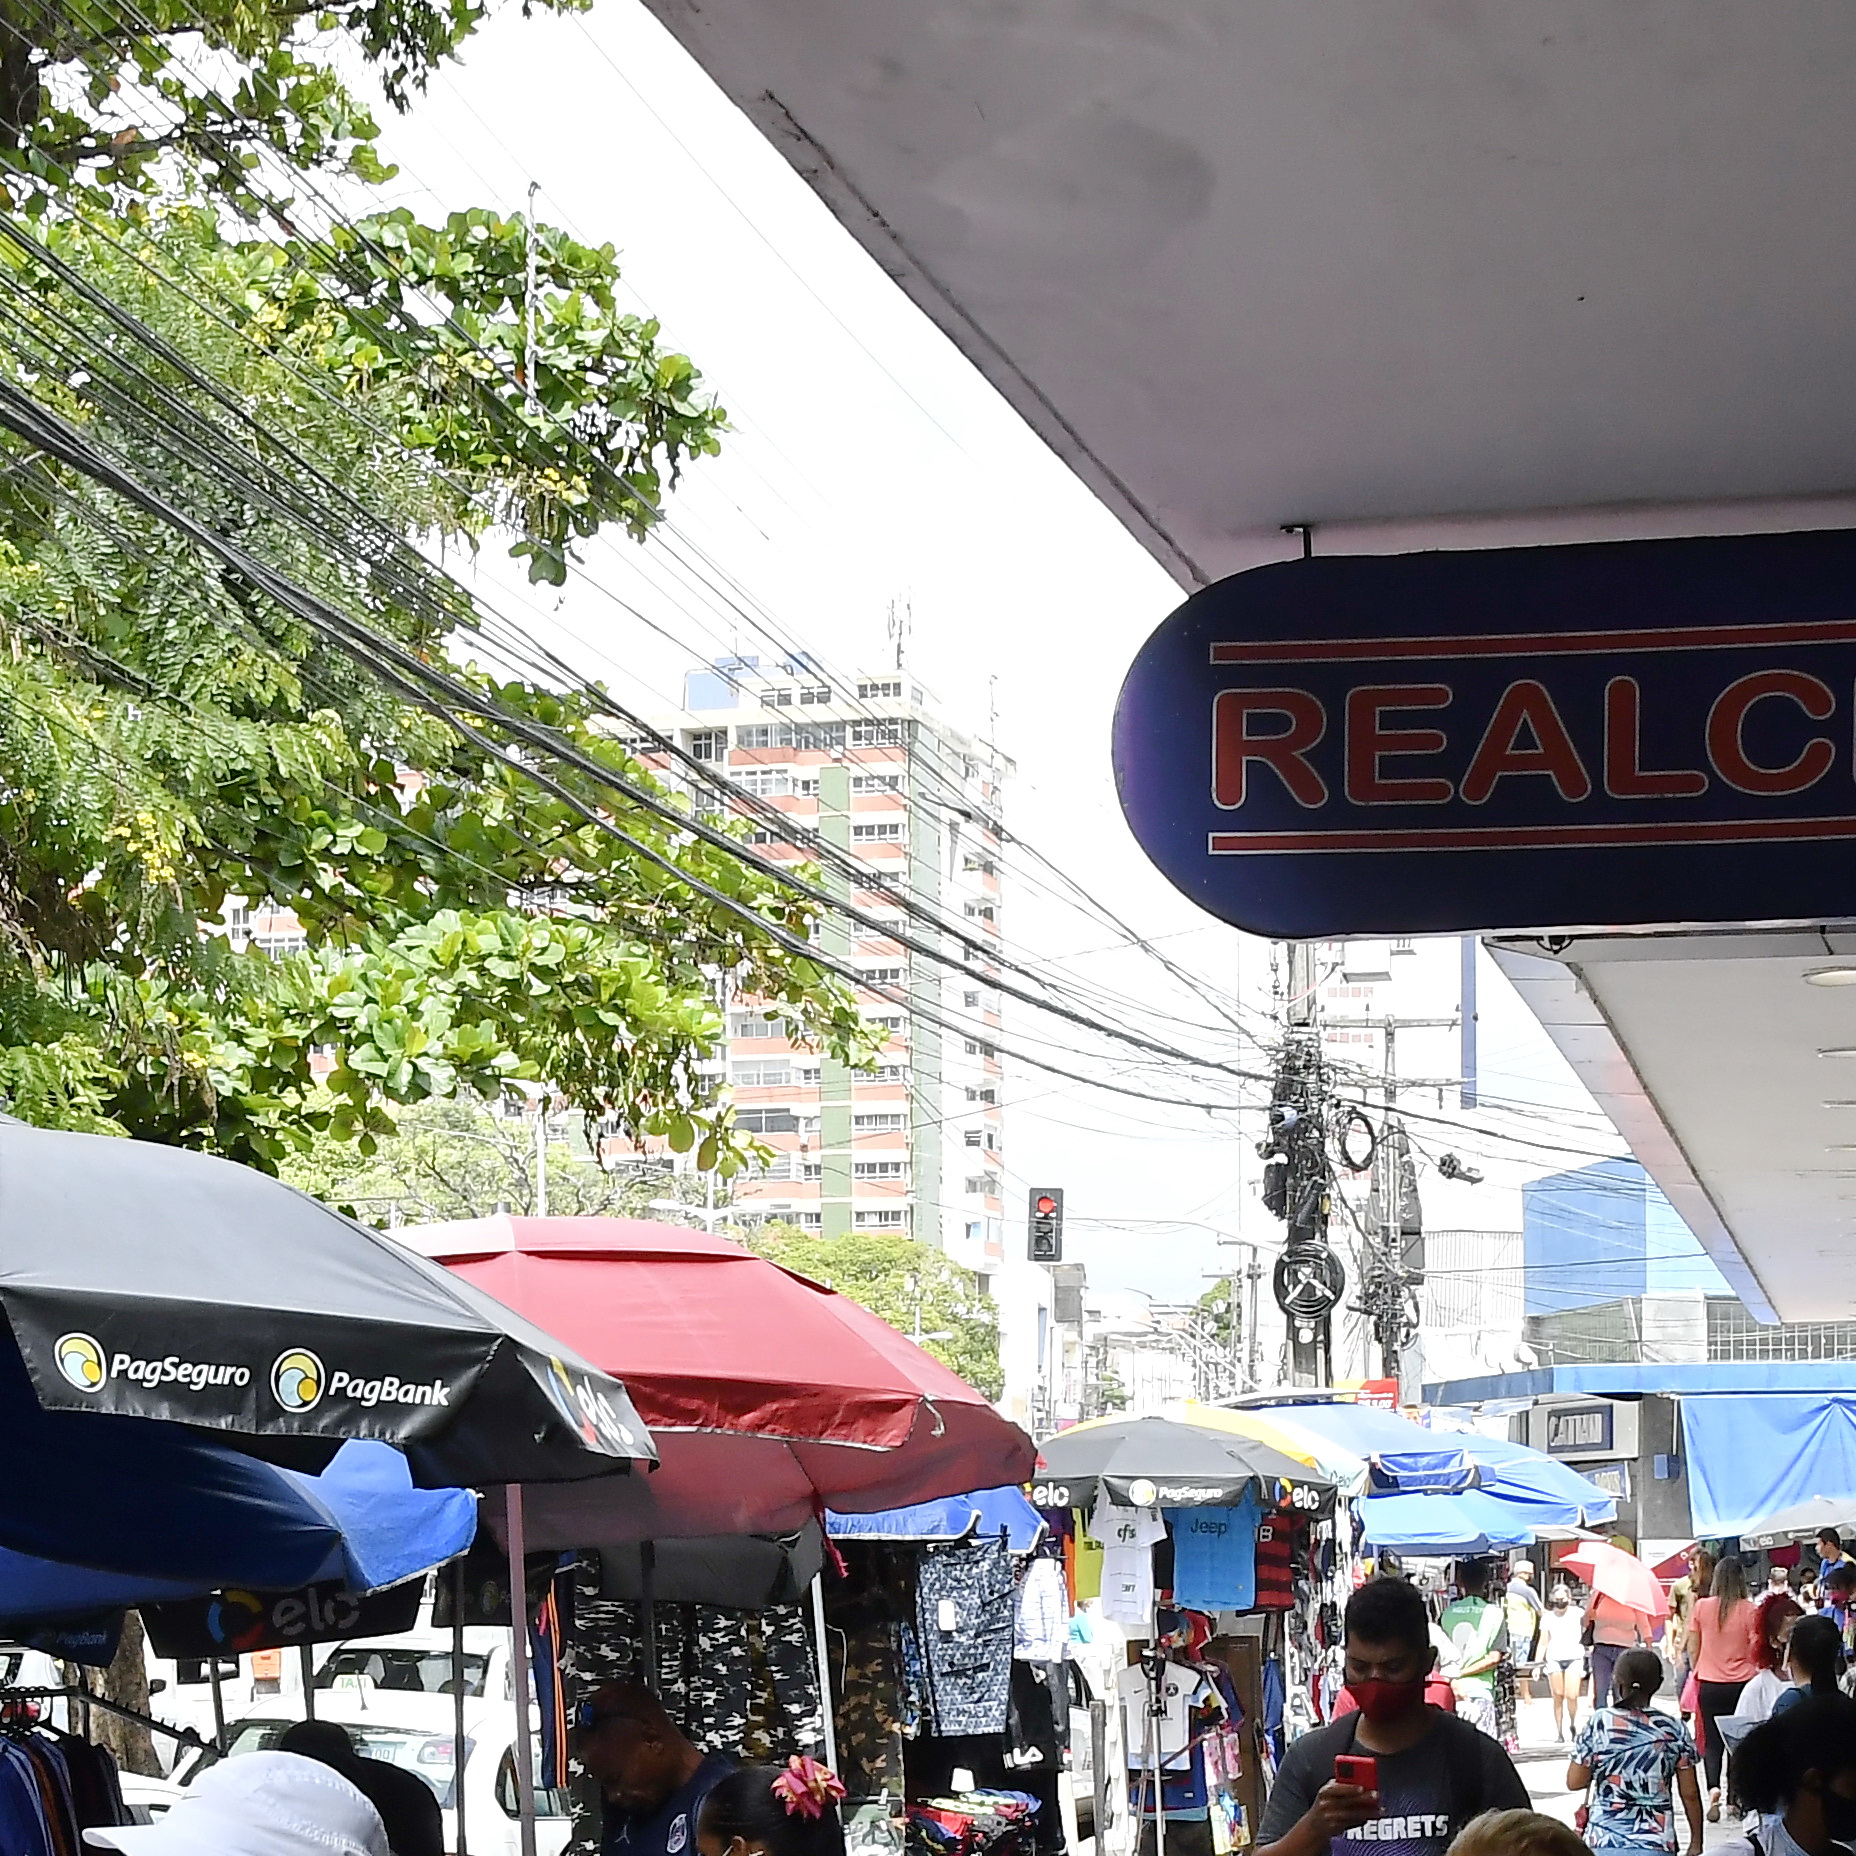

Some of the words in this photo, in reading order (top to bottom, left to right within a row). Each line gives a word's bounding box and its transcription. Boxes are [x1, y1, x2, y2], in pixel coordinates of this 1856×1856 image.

[110, 1355, 251, 1387] PagSeguro
[328, 1370, 450, 1407] PagBank
[1033, 1482, 1070, 1507] elo
[1158, 1486, 1224, 1503] PagSeguro
[1293, 1486, 1321, 1510] elo
[1190, 1517, 1227, 1538] Jeep
[272, 1586, 360, 1637] elo
